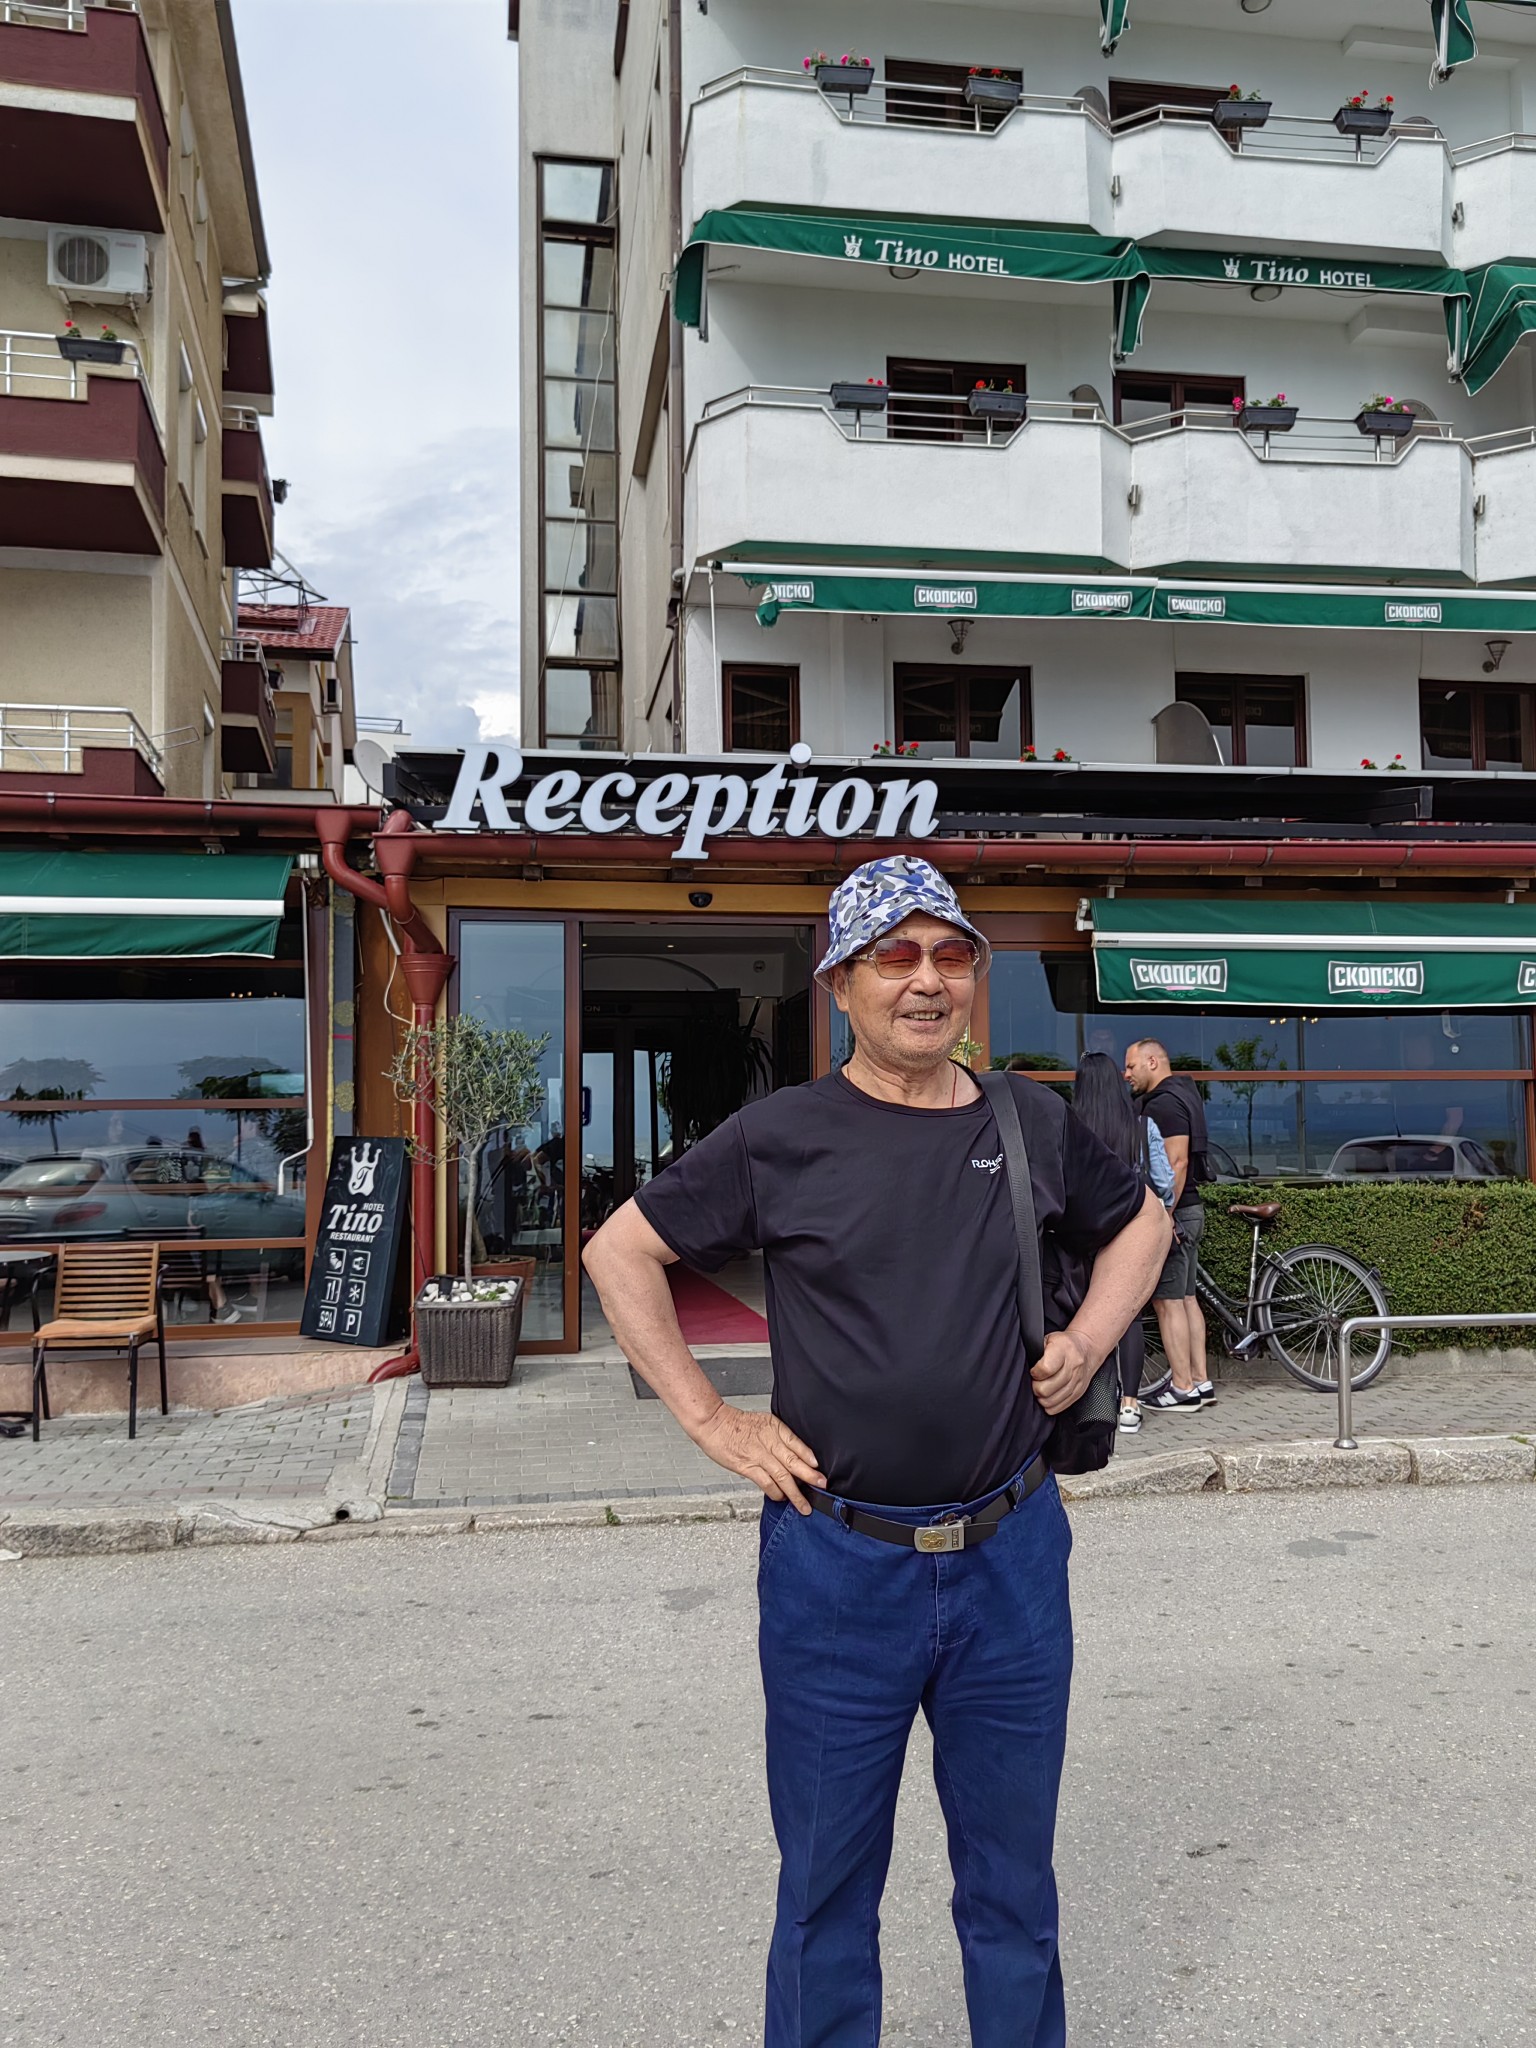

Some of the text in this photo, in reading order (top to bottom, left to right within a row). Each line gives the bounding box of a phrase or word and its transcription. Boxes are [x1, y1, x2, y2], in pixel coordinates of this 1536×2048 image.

[874, 239, 938, 266] Tino
[948, 253, 1010, 275] HOTEL
[1250, 260, 1309, 283] Tino
[1319, 269, 1376, 288] HOTEL
[918, 587, 974, 605] СКОПСКО
[1075, 593, 1129, 610] СКОПСКО
[1171, 597, 1222, 614] СКОПСКО
[1387, 604, 1438, 620] СКОПСКО
[433, 742, 940, 860] Reception
[1136, 963, 1221, 986] СКОПСКО
[1333, 966, 1418, 988] СКОПСКО
[362, 1202, 385, 1212] HOTEL
[327, 1203, 383, 1233] Tino
[329, 1231, 375, 1243] RESTAURANT
[318, 1310, 333, 1329] SPA
[346, 1313, 357, 1332] P
